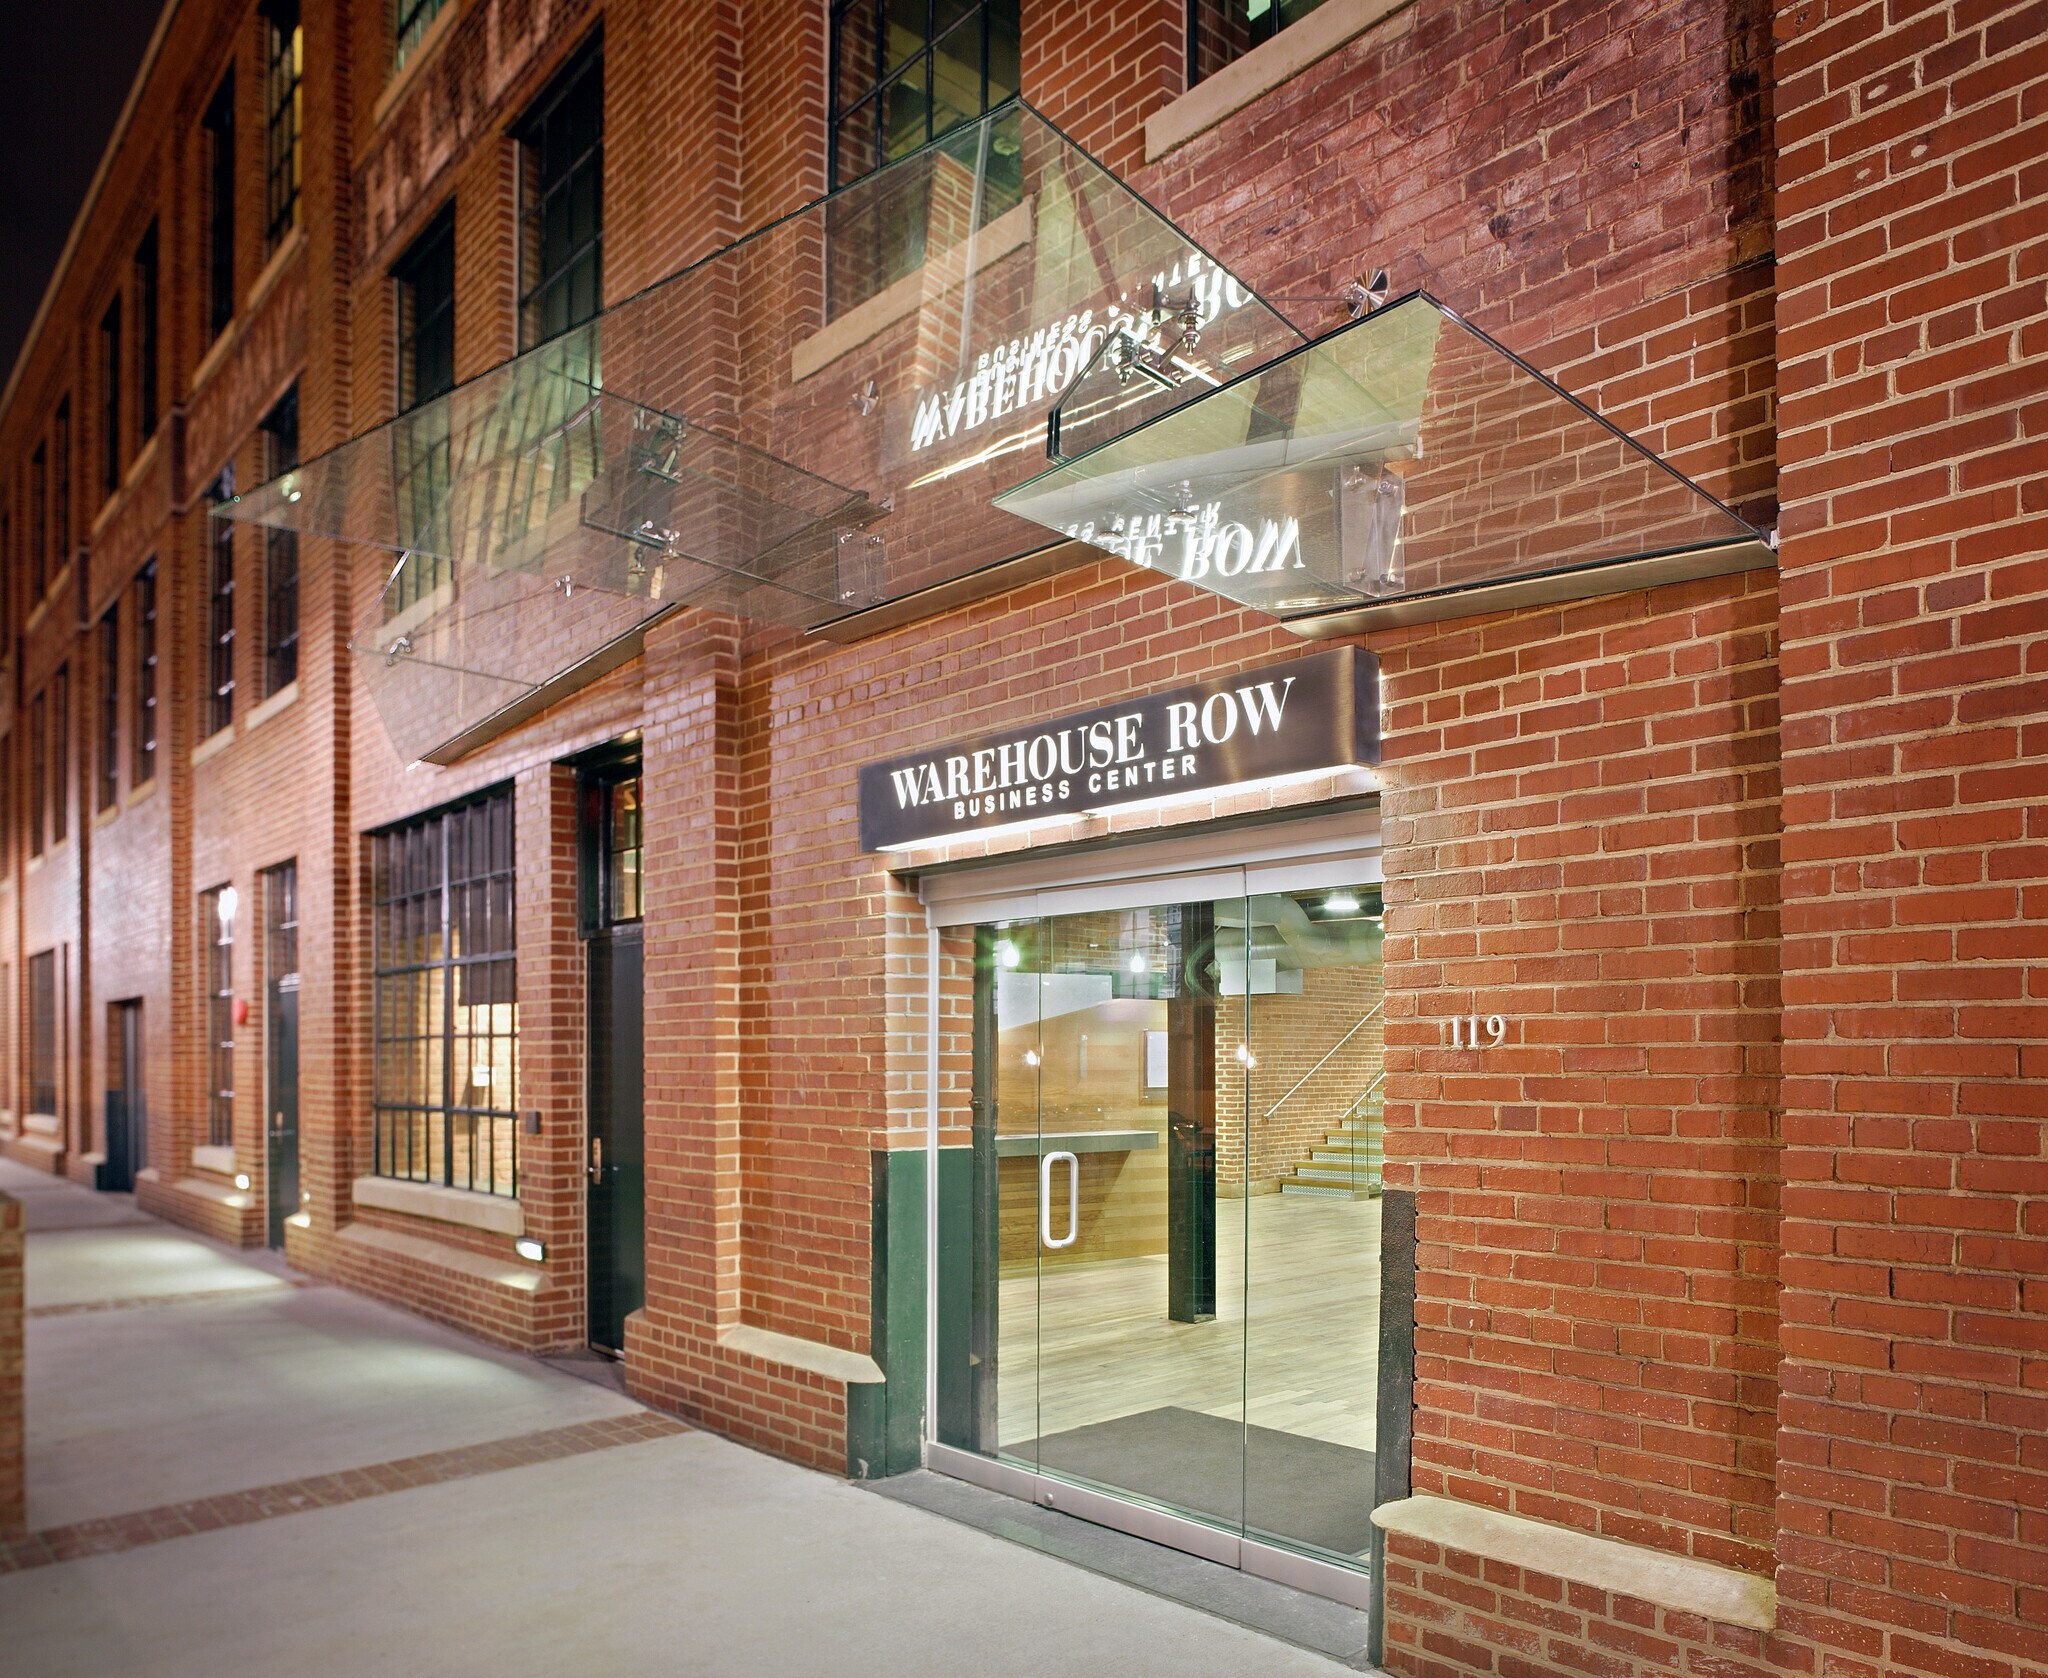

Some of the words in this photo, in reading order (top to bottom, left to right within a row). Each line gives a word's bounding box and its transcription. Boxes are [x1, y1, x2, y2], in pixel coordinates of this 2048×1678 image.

[890, 712, 1145, 810] WAREHOUSE
[1166, 677, 1297, 753] ROW
[953, 779, 1071, 820] BUSINESS
[1088, 754, 1198, 794] CENTER
[1450, 1014, 1506, 1049] 119
